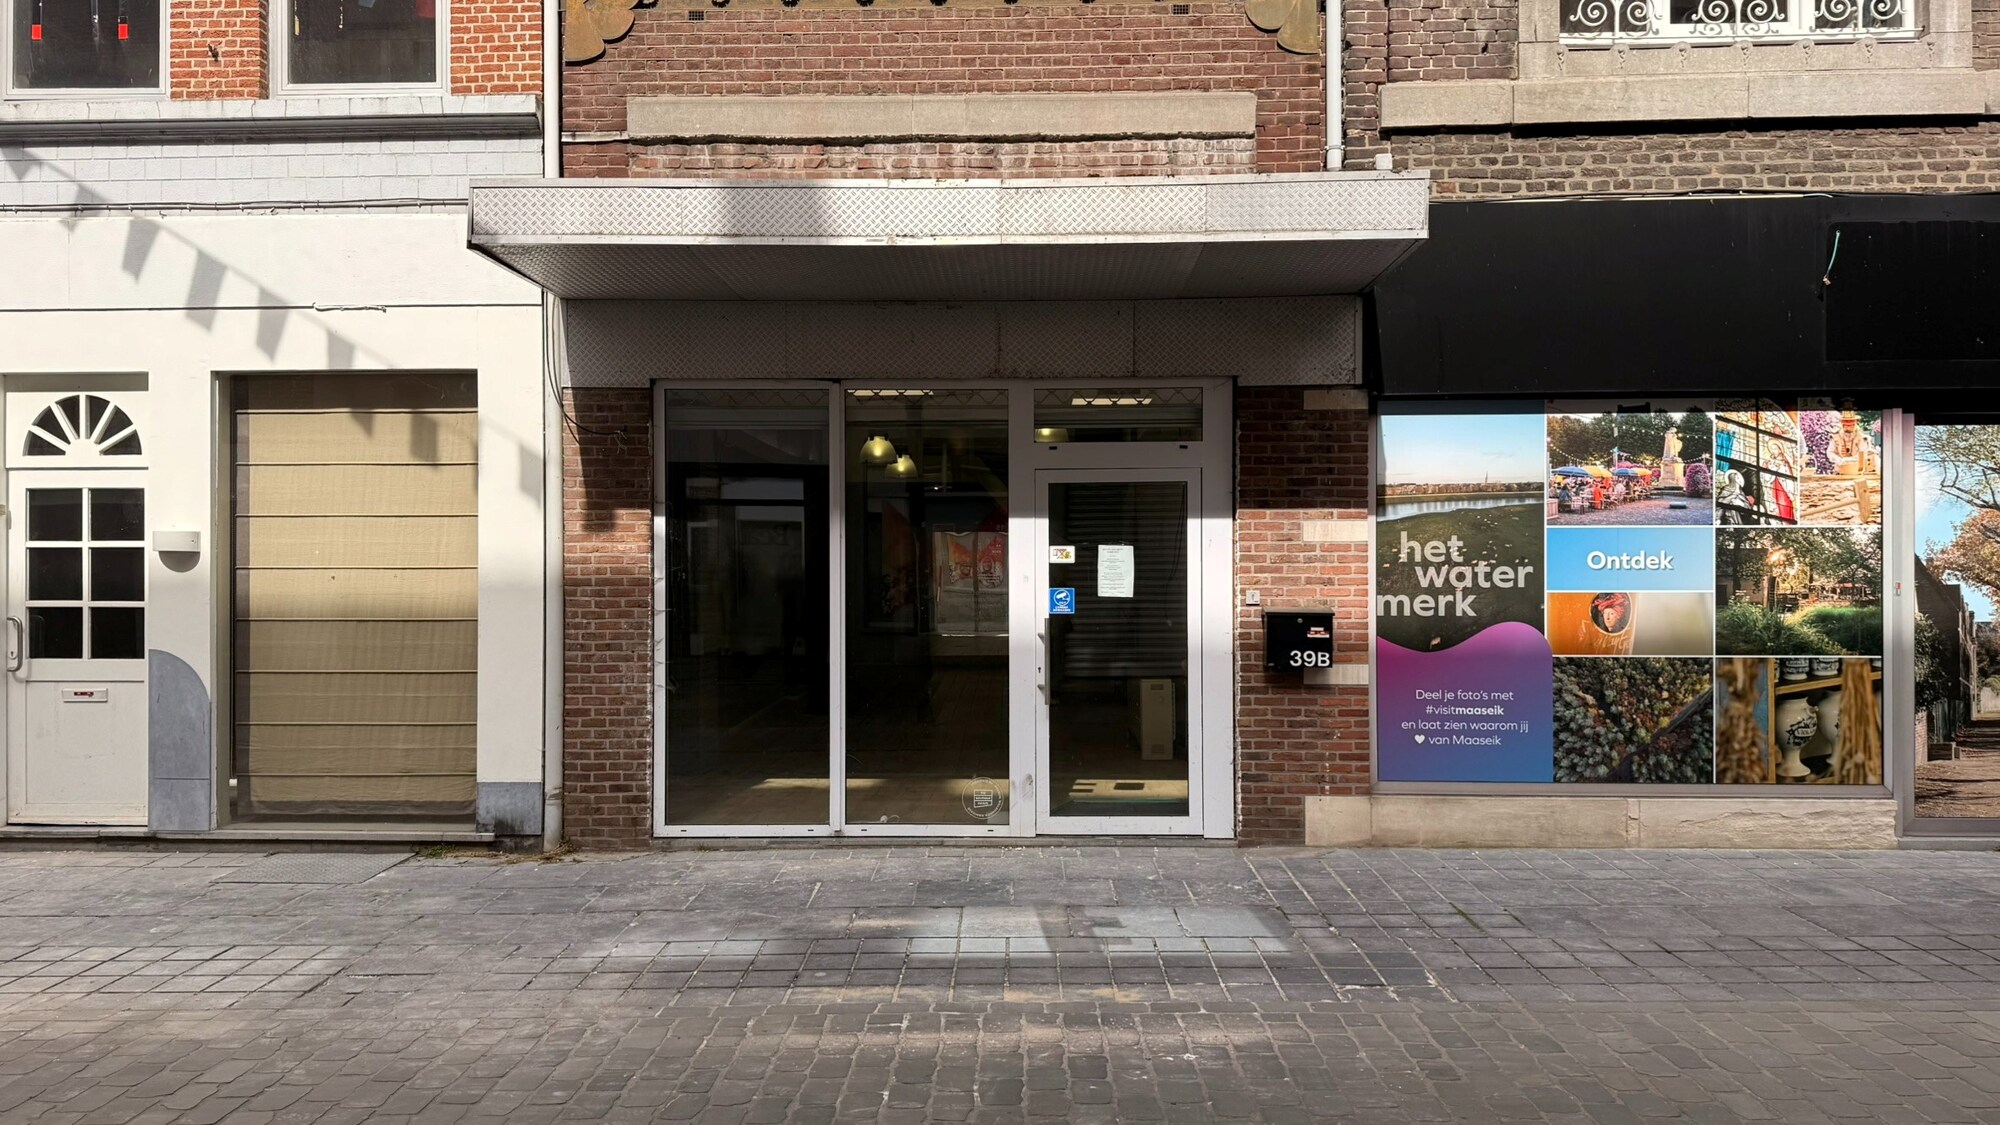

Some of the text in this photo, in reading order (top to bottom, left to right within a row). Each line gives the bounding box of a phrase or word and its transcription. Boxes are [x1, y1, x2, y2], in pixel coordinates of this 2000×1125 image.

[1400, 531, 1464, 563] het
[1586, 550, 1674, 571] Ontdek
[1414, 560, 1534, 588] water
[1376, 590, 1477, 617] merk
[1289, 650, 1331, 667] 39B
[1415, 689, 1515, 702] Deel je foto's met
[1425, 704, 1505, 716] #visitmaaseik
[1401, 719, 1529, 733] en laat zien waarom jij
[1428, 735, 1502, 746] van Maaseik
